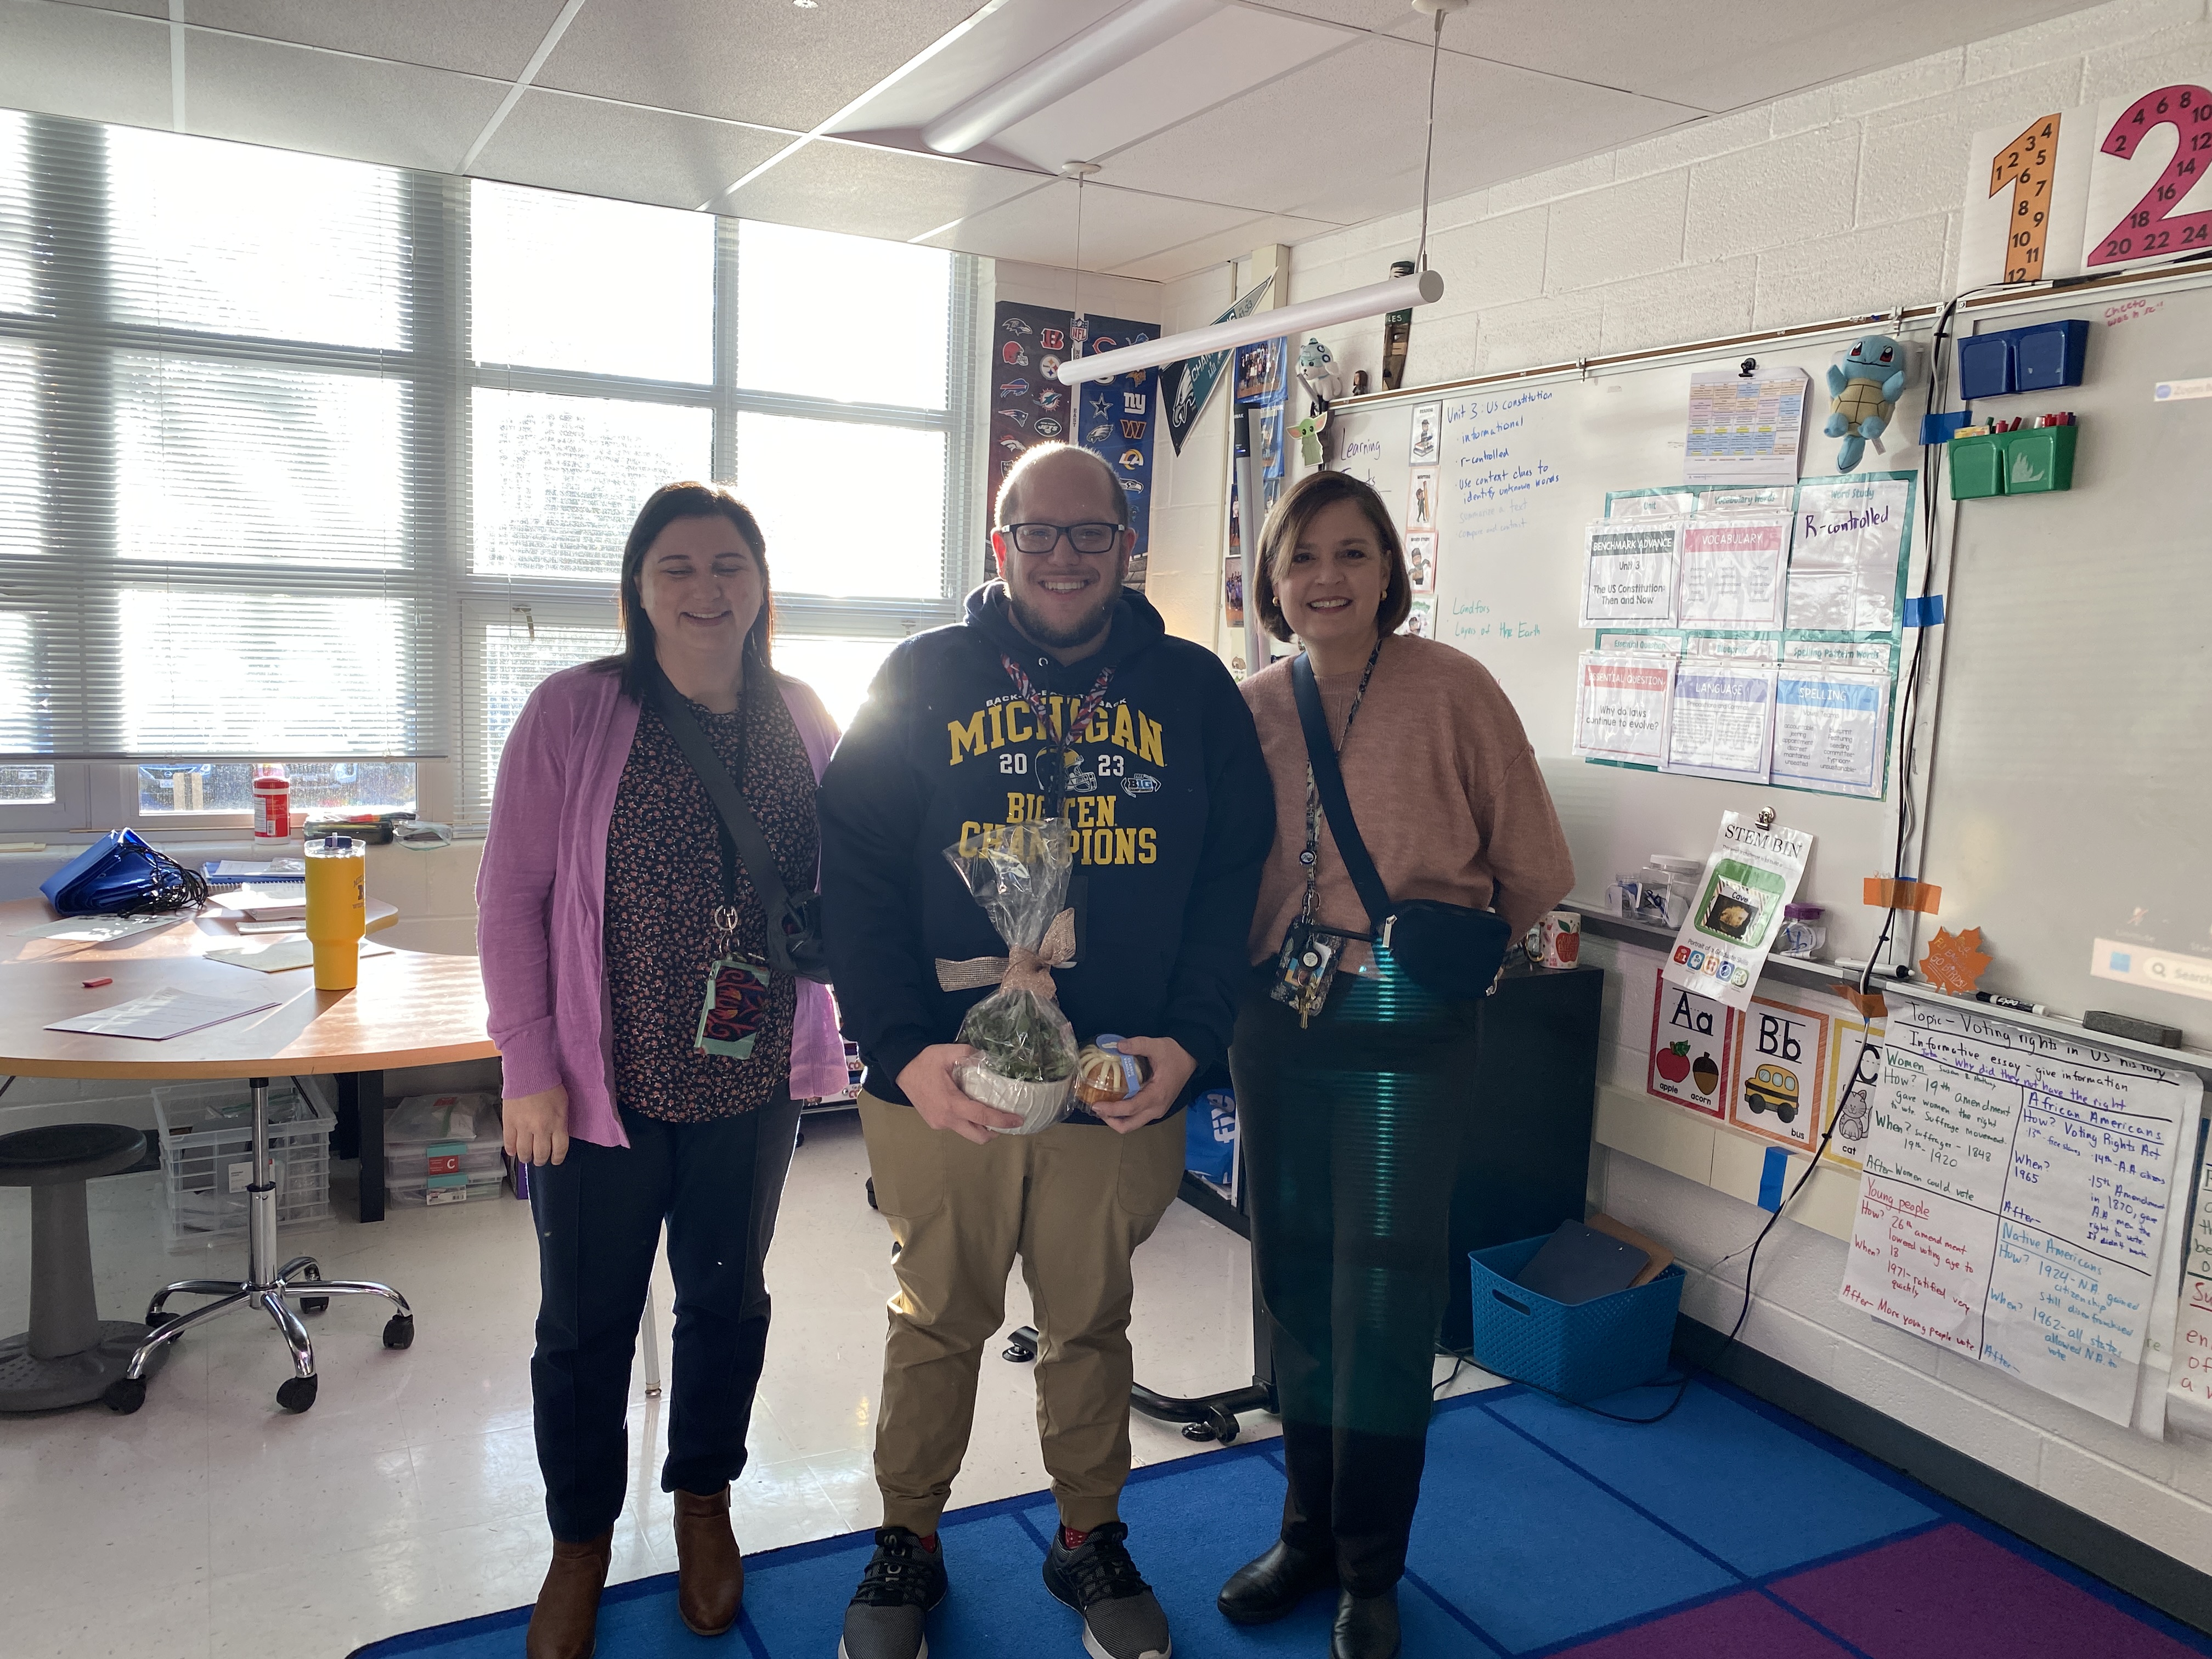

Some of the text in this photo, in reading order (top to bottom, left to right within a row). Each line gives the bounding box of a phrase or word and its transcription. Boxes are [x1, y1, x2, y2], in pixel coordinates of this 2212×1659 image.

[2157, 97, 2169, 114] 6
[2180, 91, 2191, 109] 8
[2132, 109, 2145, 124] 4
[2192, 104, 2212, 123] 10
[2041, 123, 2052, 138] 4
[2025, 136, 2036, 151] 3
[2114, 135, 2126, 153] 2
[2191, 132, 2212, 151] 12
[2007, 151, 2019, 168] 2
[2035, 149, 2046, 165] 5
[1996, 166, 2003, 180] 1
[2019, 168, 2031, 183] 6
[2177, 158, 2196, 177] 14
[2034, 179, 2047, 197] 7
[2157, 183, 2176, 201] 16
[2018, 200, 2029, 216] 8
[2034, 212, 2044, 228] 9
[2130, 211, 2150, 229] 18
[2012, 230, 2031, 248] 10
[2143, 231, 2170, 251] 22
[2181, 224, 2208, 244] 24
[2027, 247, 2039, 263] 11
[2105, 238, 2132, 257] 20
[2008, 267, 2027, 283] 12
[1071, 329, 1086, 338] NFL
[1447, 390, 1553, 423] Unit US constitution
[1462, 415, 1523, 444] informational
[1341, 427, 1381, 461] Learning
[1461, 448, 1509, 467] r-controlled
[1459, 460, 1549, 490] Use context clues to
[1463, 474, 1559, 504] identify unknown words
[1831, 487, 1875, 500] Word Study
[1644, 501, 1656, 510] Unit
[1714, 495, 1753, 506] Vocabulary
[1805, 505, 1889, 539] R-controlled
[1593, 538, 1672, 551] BENCHMARK ADVANCE
[1702, 533, 1762, 545] VOCABULARY
[1619, 561, 1640, 571] Unit 3
[1594, 585, 1605, 594] The
[1607, 584, 1616, 593] US
[1602, 595, 1654, 605] Then and Now
[1518, 620, 1541, 639] Earth
[1615, 640, 1666, 649] Essential Question
[1716, 645, 1748, 654] Blueprint
[1794, 647, 1879, 659] Spelling Pattern Words
[1589, 673, 1624, 684] ESSENTIAL
[1695, 682, 1742, 695] LANGUAGE
[1798, 687, 1847, 702] SPELLING
[1600, 705, 1646, 717] Why do laws
[1586, 716, 1659, 731] continue to evolve?
[1000, 753, 1124, 777] 20 23
[1129, 779, 1153, 788] BIG
[1724, 824, 1770, 849] STEM
[1770, 837, 1803, 859] BIN
[1731, 891, 1749, 903] Cave
[1688, 938, 1705, 950] Portrait
[1715, 948, 1736, 961] Graduate
[1737, 957, 1749, 966] Skills
[1934, 937, 1946, 950] FLY
[1930, 953, 1944, 966] GO
[1941, 963, 1968, 989] BIRDS!
[1997, 997, 2018, 1006] EXPO
[1671, 991, 1713, 1035] Aa
[1759, 1015, 1802, 1061] Bb
[1905, 1001, 2110, 1062] Topic Voting rights in US
[1127, 1057, 1135, 1076] CLASSIC
[1886, 1048, 1925, 1072] Women
[1910, 1030, 2128, 1092] Informative essay give information
[1660, 1082, 1678, 1094] apple
[1979, 1064, 2126, 1111] did have right
[1691, 1092, 1712, 1105] acorn
[1922, 1099, 1971, 1120] women the
[2029, 1091, 2162, 1141] African Americans
[1791, 1128, 1805, 1140] bus
[2023, 1108, 2162, 1160] How? Voting Rights Act
[1842, 1144, 1857, 1155] cat
[1930, 1148, 1957, 1167] 1920
[1968, 1145, 1991, 1163] 1848
[2015, 1150, 2051, 1173] When?
[2015, 1166, 2040, 1184] 1965
[1855, 1234, 1899, 1258] When? 18
[2002, 1222, 2041, 1249] Native
[2046, 1238, 2103, 1276] Americans
